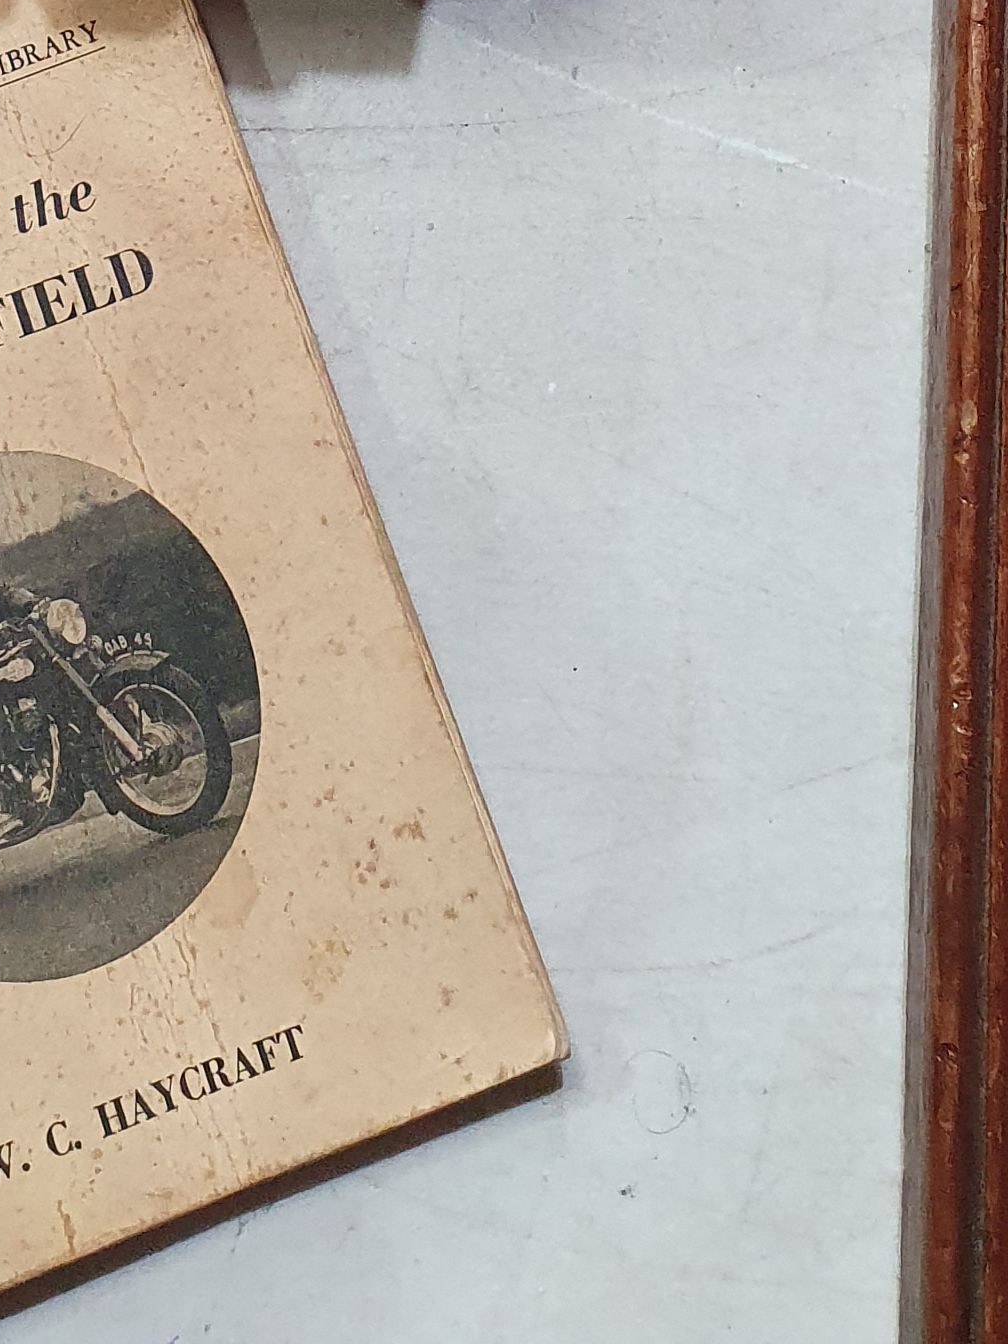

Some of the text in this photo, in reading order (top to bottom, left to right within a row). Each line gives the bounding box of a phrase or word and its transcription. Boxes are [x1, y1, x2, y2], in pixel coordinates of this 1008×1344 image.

[10, 176, 95, 233] the
[47, 1119, 83, 1155] C.
[94, 1024, 307, 1140] HAYCRAFT
